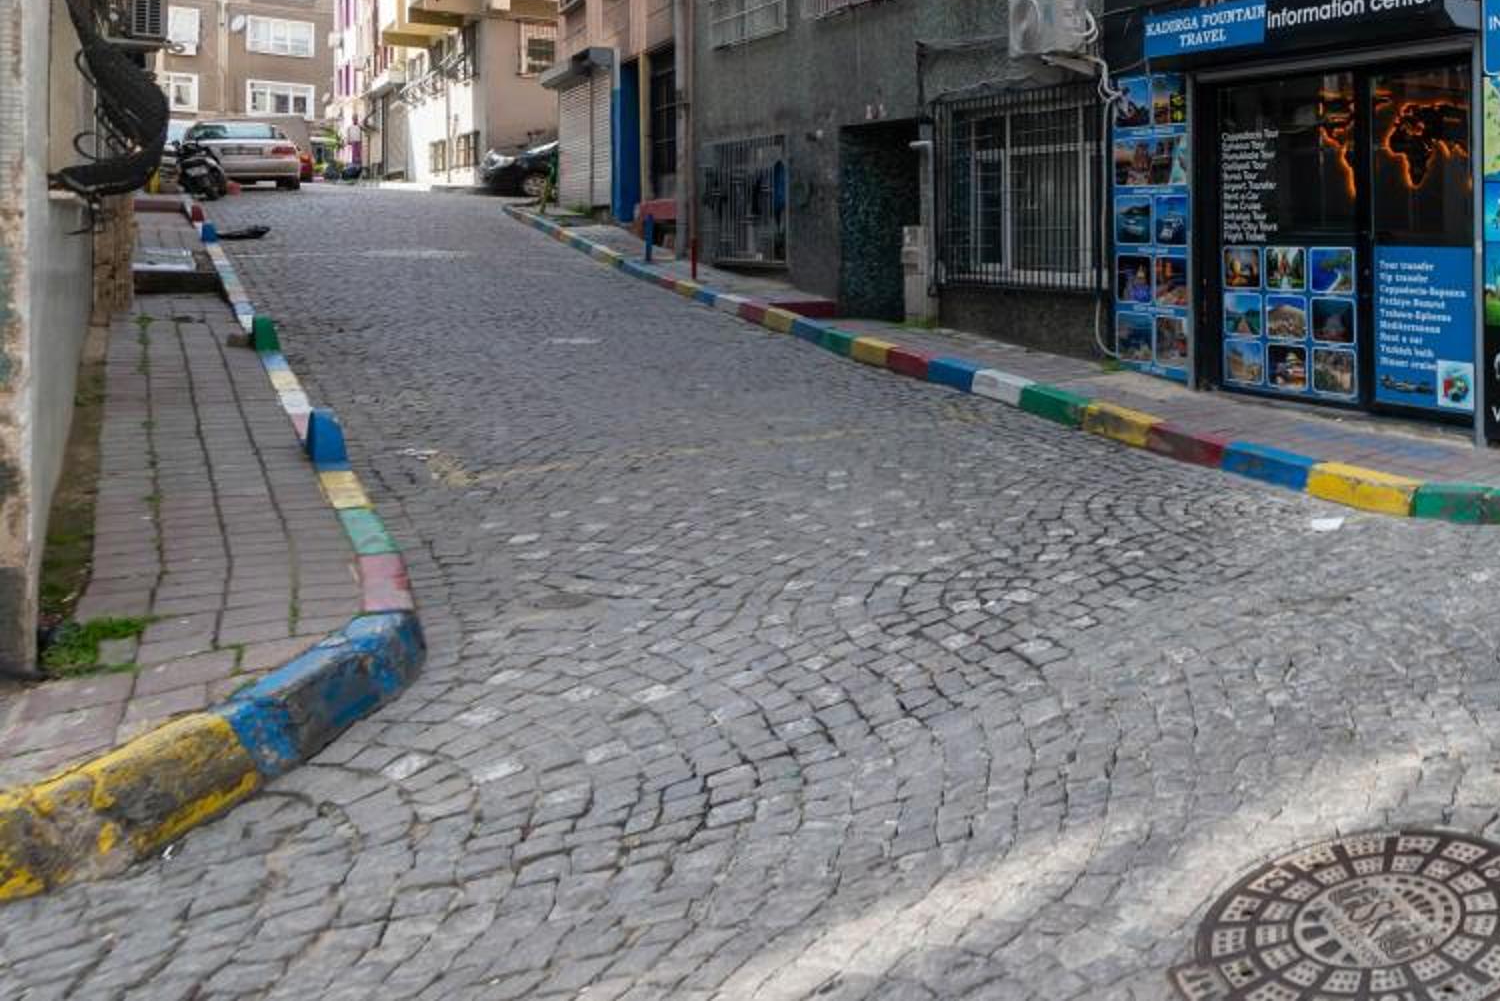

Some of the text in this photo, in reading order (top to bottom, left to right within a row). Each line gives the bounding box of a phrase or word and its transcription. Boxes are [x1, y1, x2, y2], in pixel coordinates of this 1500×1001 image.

[1201, 4, 1266, 26] FOUNTAIN
[1267, 0, 1365, 29] Information
[1180, 26, 1227, 47] TRAVEL
